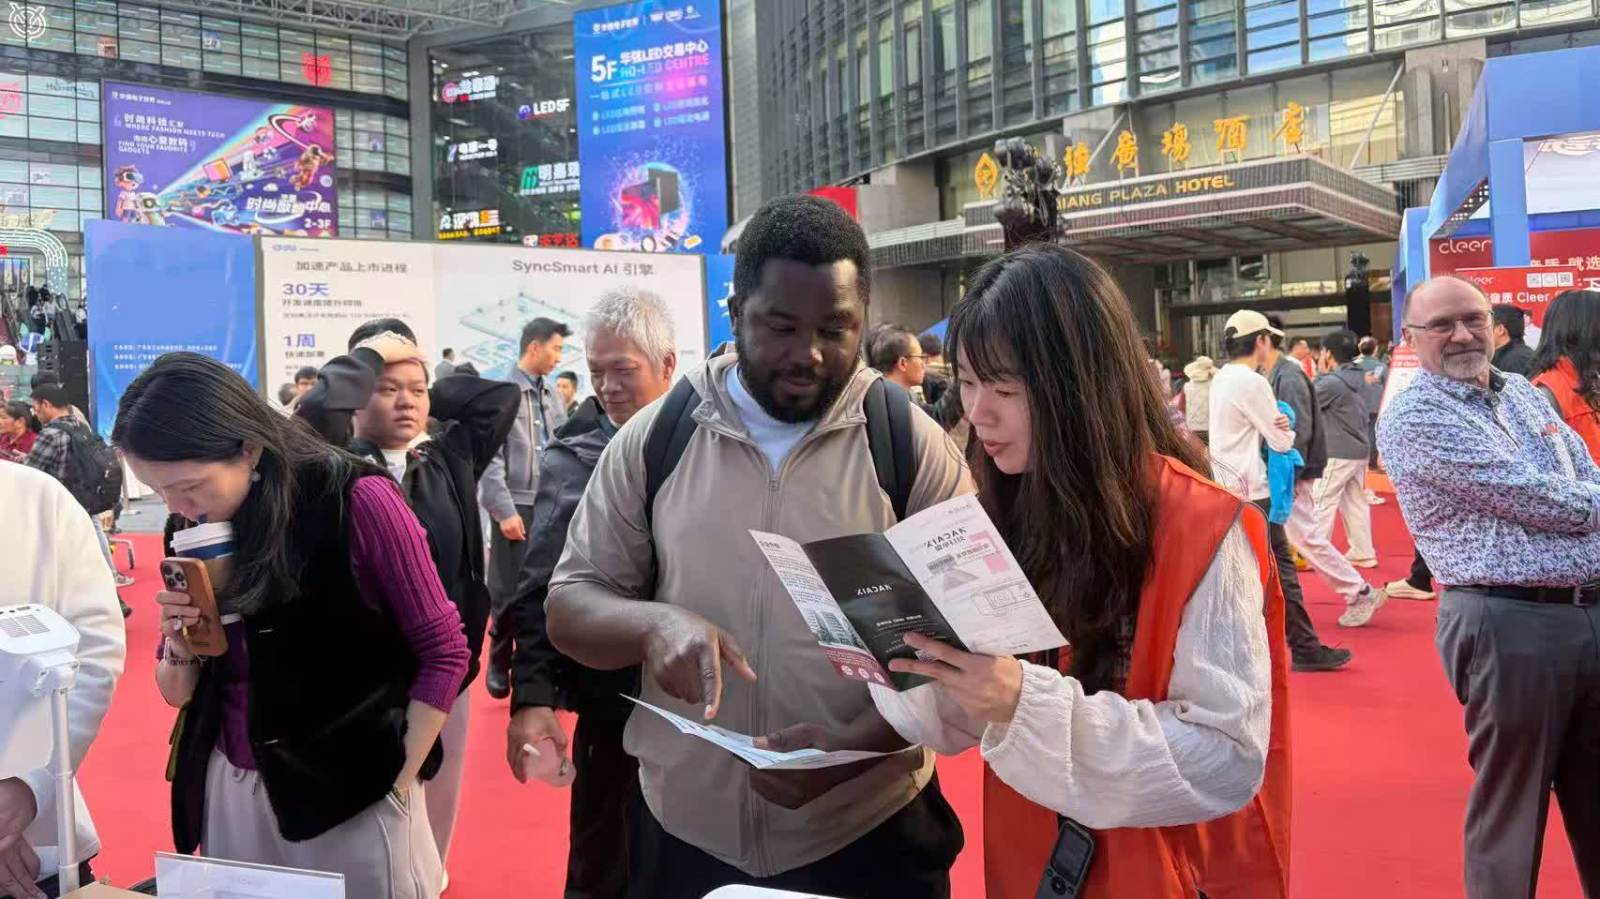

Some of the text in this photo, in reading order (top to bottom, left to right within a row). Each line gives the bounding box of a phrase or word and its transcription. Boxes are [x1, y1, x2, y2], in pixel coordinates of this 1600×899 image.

[591, 54, 618, 82] 5F
[1110, 184, 1168, 203] PLAZA
[1176, 175, 1235, 194] HOTEL
[1438, 239, 1492, 254] cleer
[296, 261, 408, 273] 加速产品上市进程
[512, 259, 599, 275] SyncSmart
[603, 263, 618, 274] AI
[282, 282, 329, 297] 30天
[1517, 291, 1550, 303] Cleer
[284, 333, 315, 348] 1周
